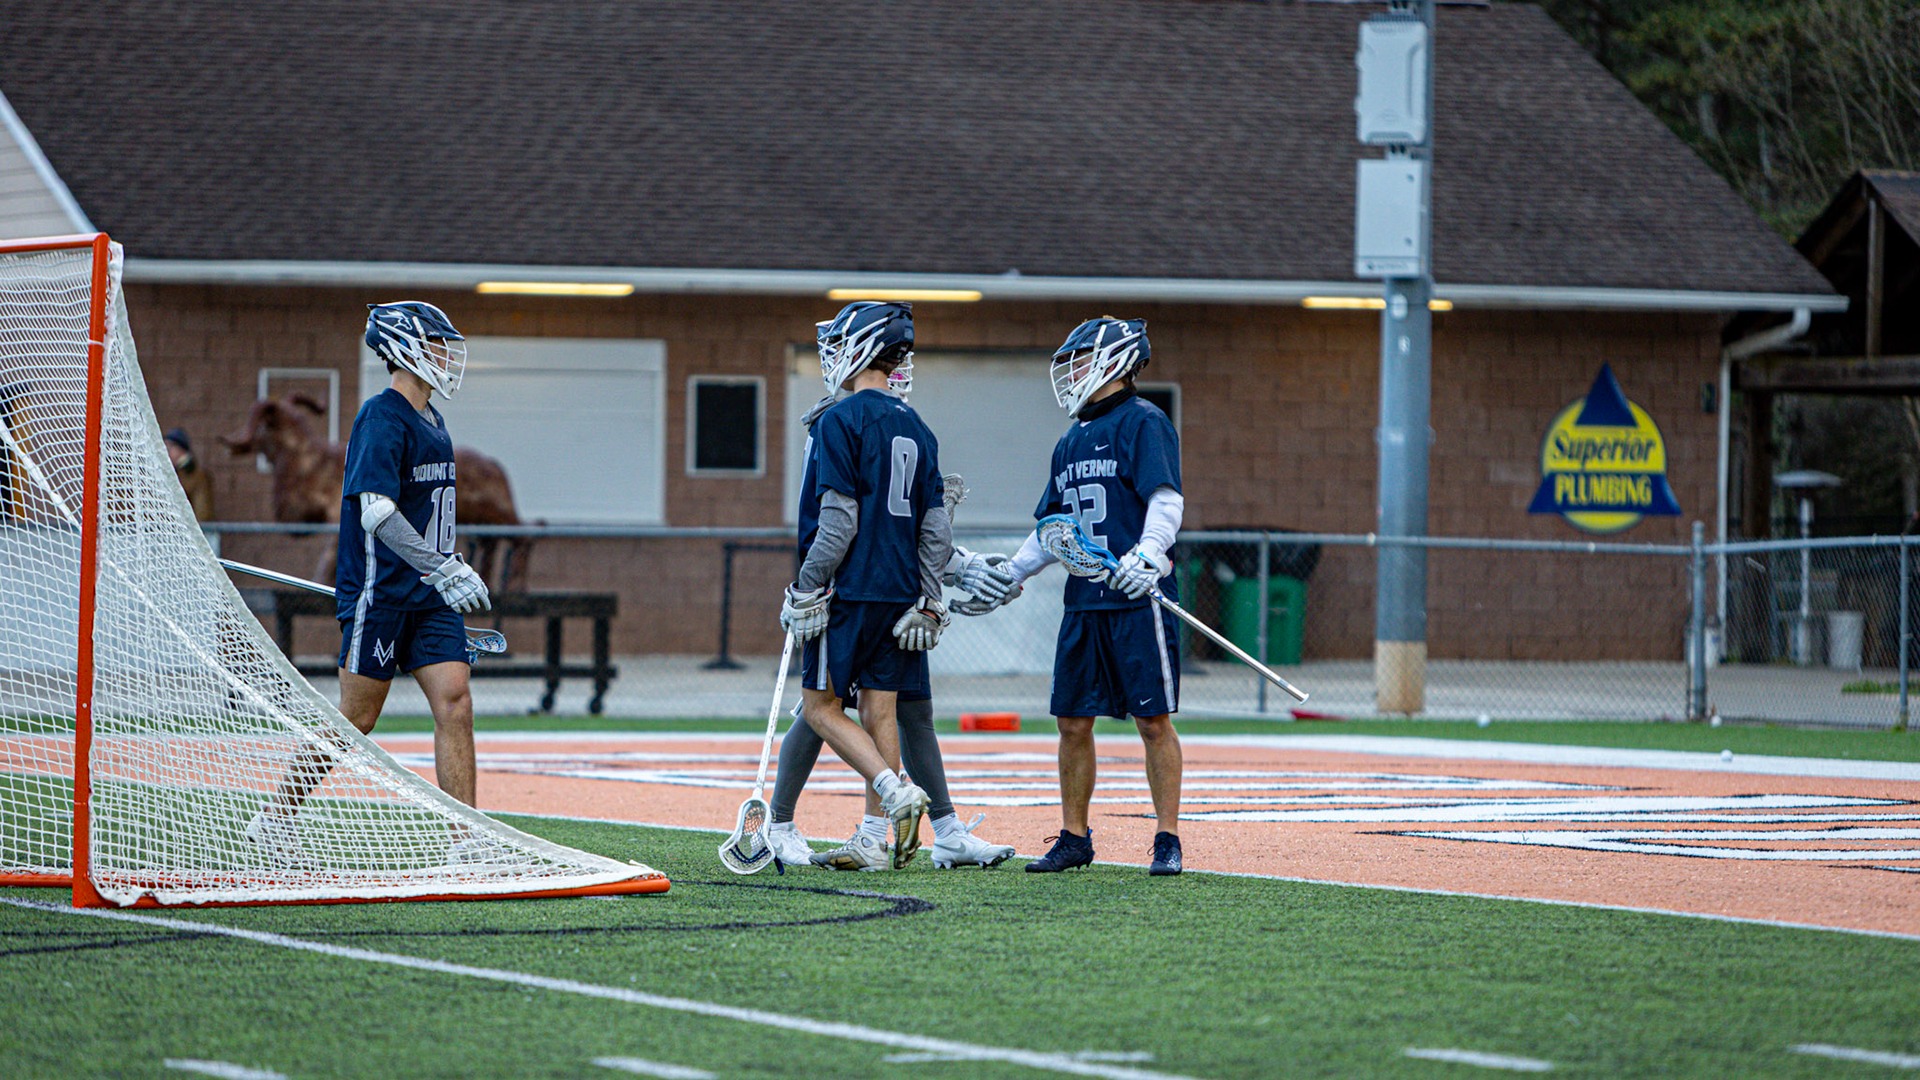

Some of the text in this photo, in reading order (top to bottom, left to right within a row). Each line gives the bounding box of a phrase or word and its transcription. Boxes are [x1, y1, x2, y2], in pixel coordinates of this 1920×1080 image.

[1119, 322, 1133, 336] 2
[1553, 429, 1656, 472] Superior
[1554, 474, 1653, 505] PLUMBING
[424, 486, 456, 553] 18
